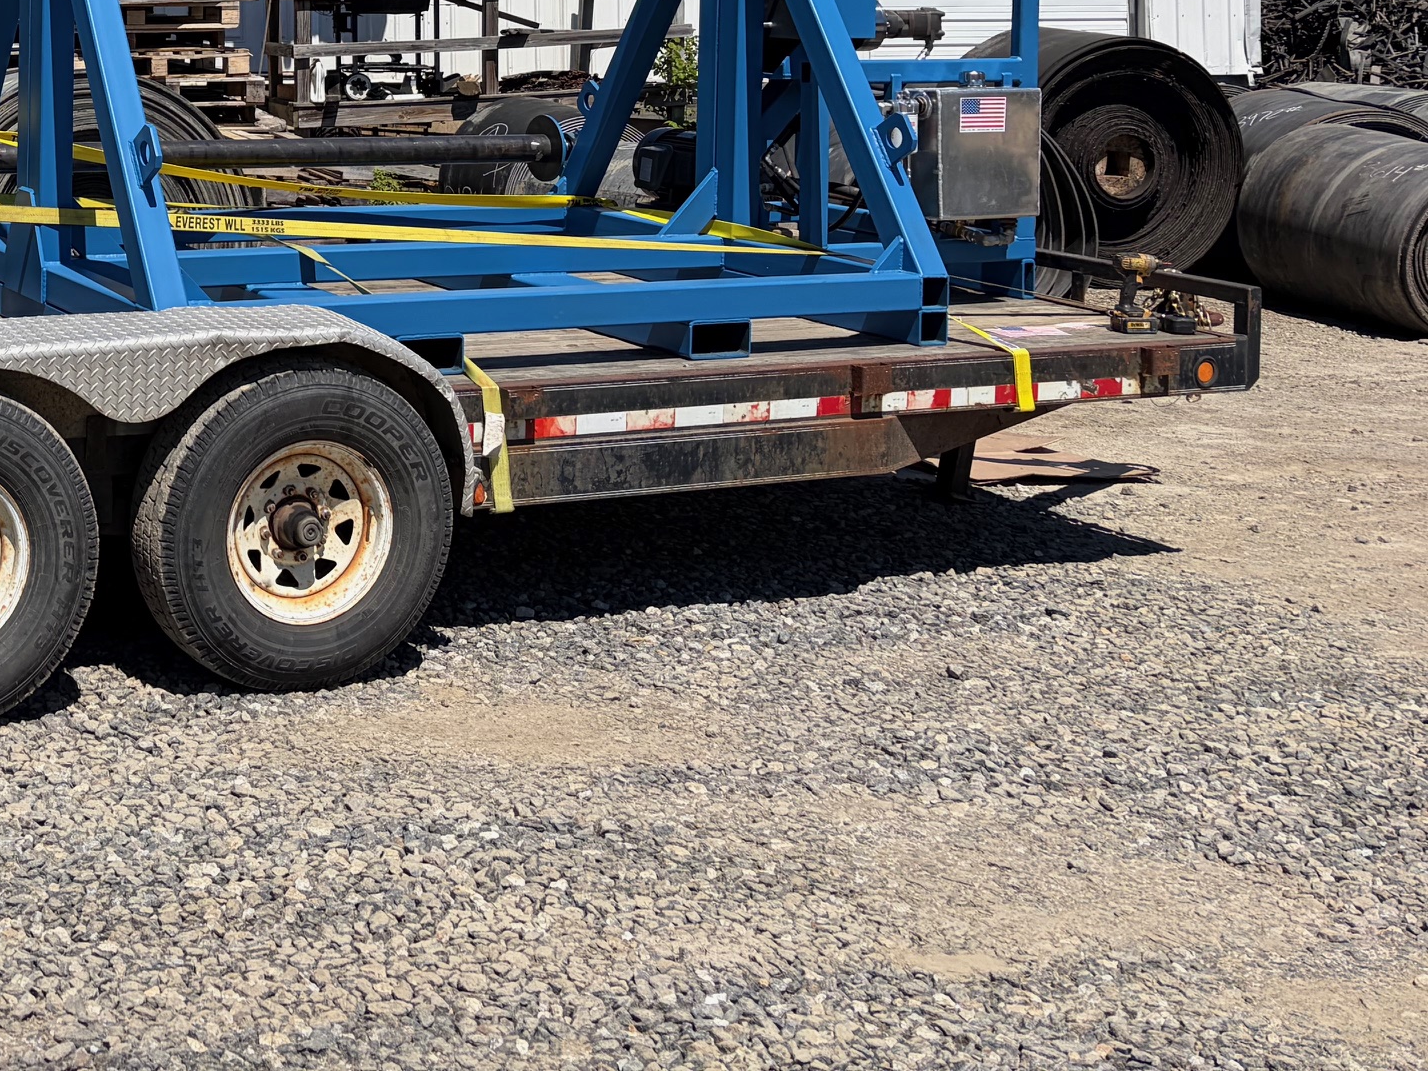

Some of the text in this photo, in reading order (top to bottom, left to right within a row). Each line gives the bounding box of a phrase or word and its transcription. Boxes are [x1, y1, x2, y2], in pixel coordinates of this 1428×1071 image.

[175, 216, 246, 232] EVEREST WLL
[321, 398, 429, 483] COOPER
[205, 605, 359, 673] DISCOVERER
